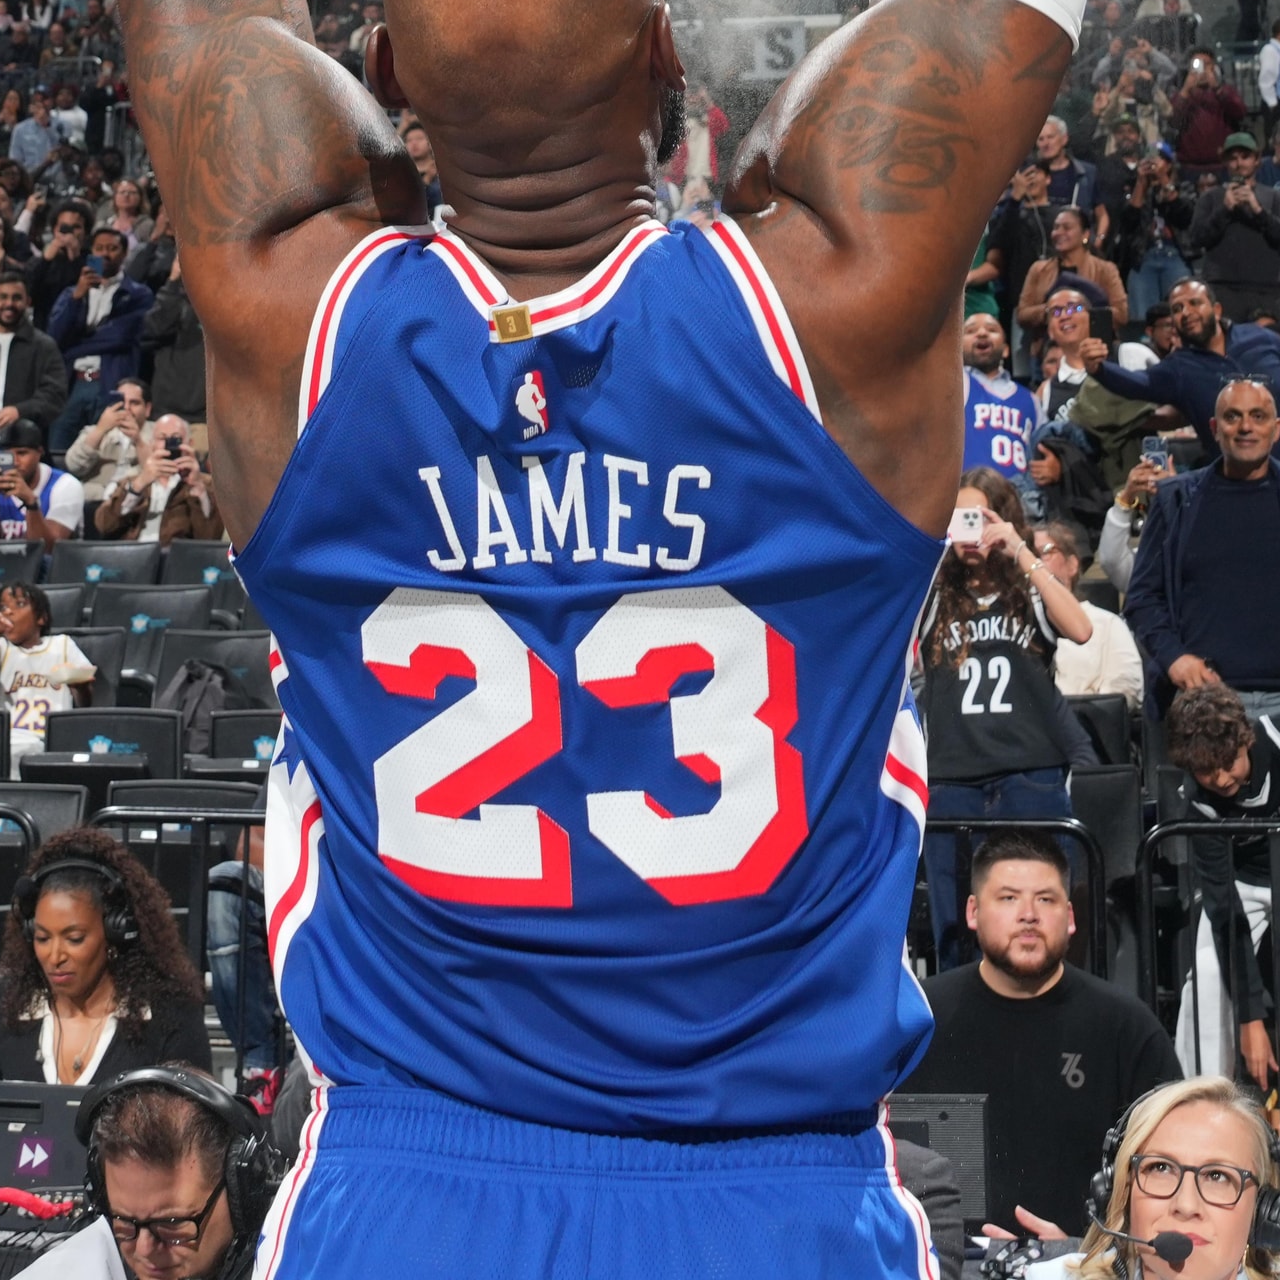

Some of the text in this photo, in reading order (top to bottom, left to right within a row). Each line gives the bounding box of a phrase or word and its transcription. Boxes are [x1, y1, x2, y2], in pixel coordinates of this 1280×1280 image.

[523, 425, 539, 440] NBA
[418, 450, 712, 573] JAMES
[959, 656, 1014, 715] 22
[11, 699, 48, 731] 23
[360, 585, 810, 908] 23
[1060, 1052, 1086, 1089] 76
